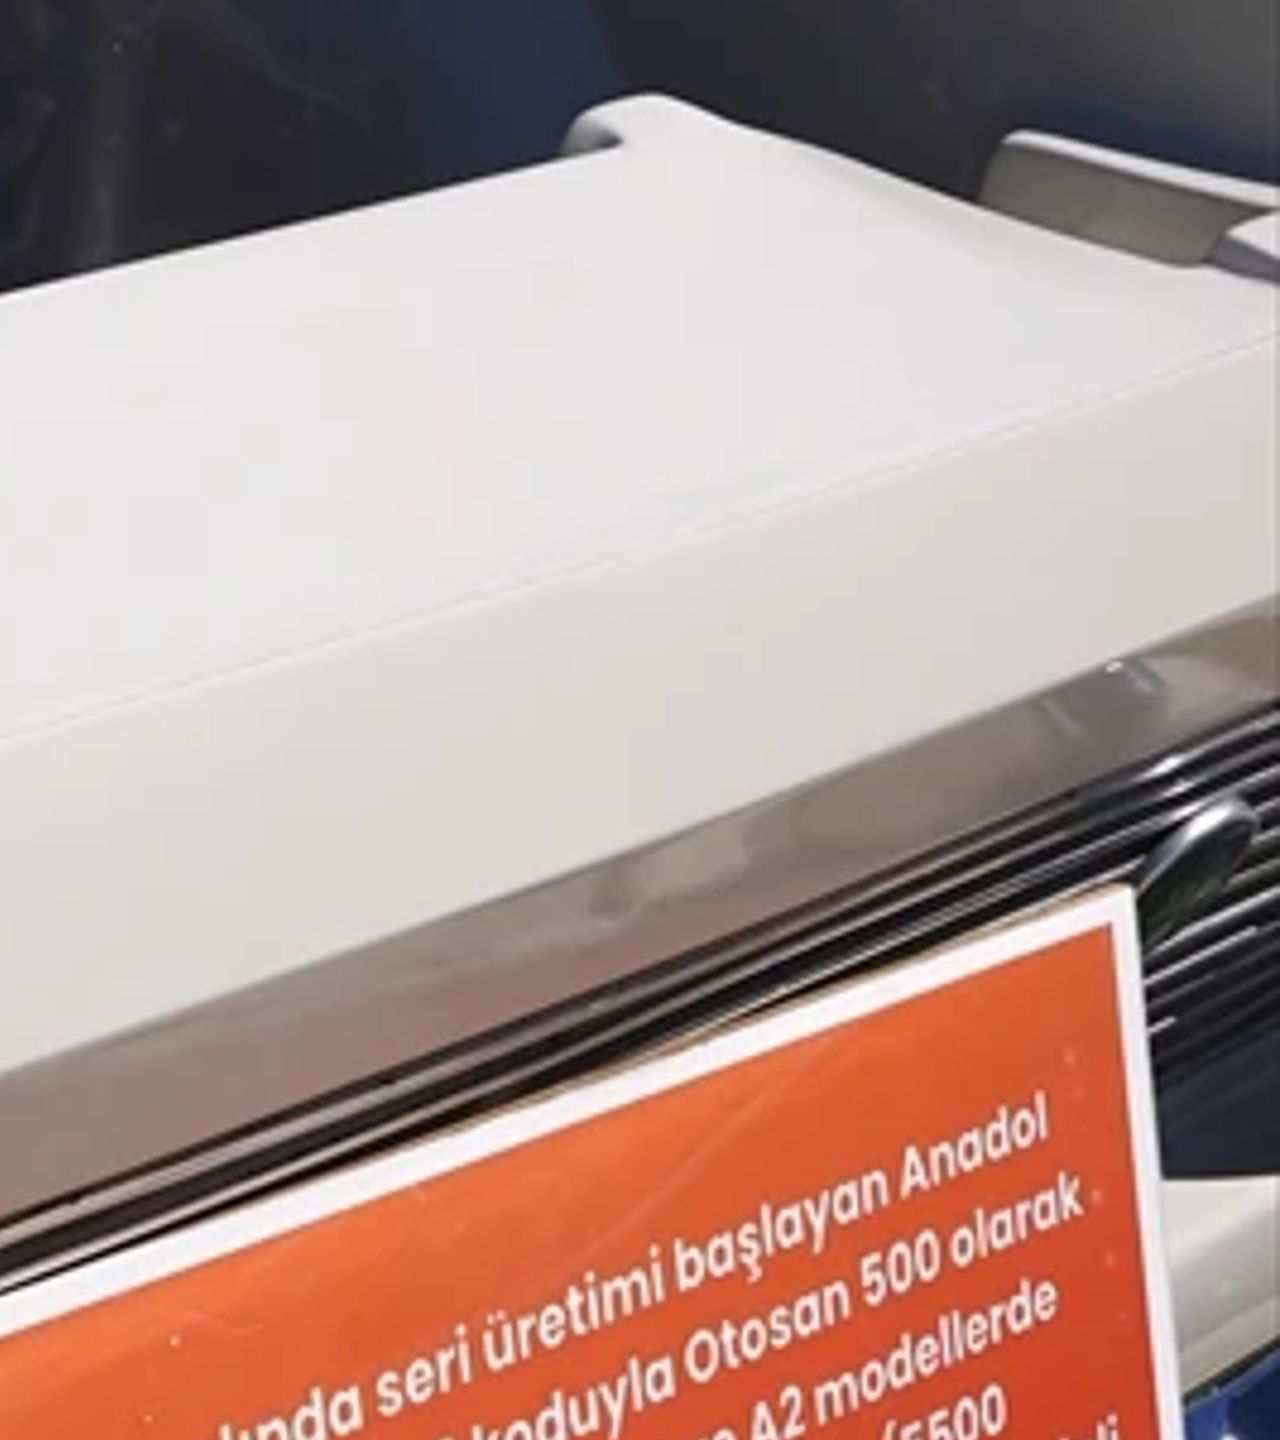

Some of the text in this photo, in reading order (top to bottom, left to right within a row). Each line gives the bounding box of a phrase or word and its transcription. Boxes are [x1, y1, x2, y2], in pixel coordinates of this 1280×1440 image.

[375, 1323, 471, 1416] seri
[481, 1244, 665, 1371] üretimi
[673, 1169, 889, 1291] başlayan
[899, 1091, 1047, 1197] Anadol
[683, 1280, 850, 1383] Otosan
[859, 1228, 940, 1306] 500
[949, 1170, 1083, 1267] olarak
[813, 1278, 1057, 1425] modellerde
